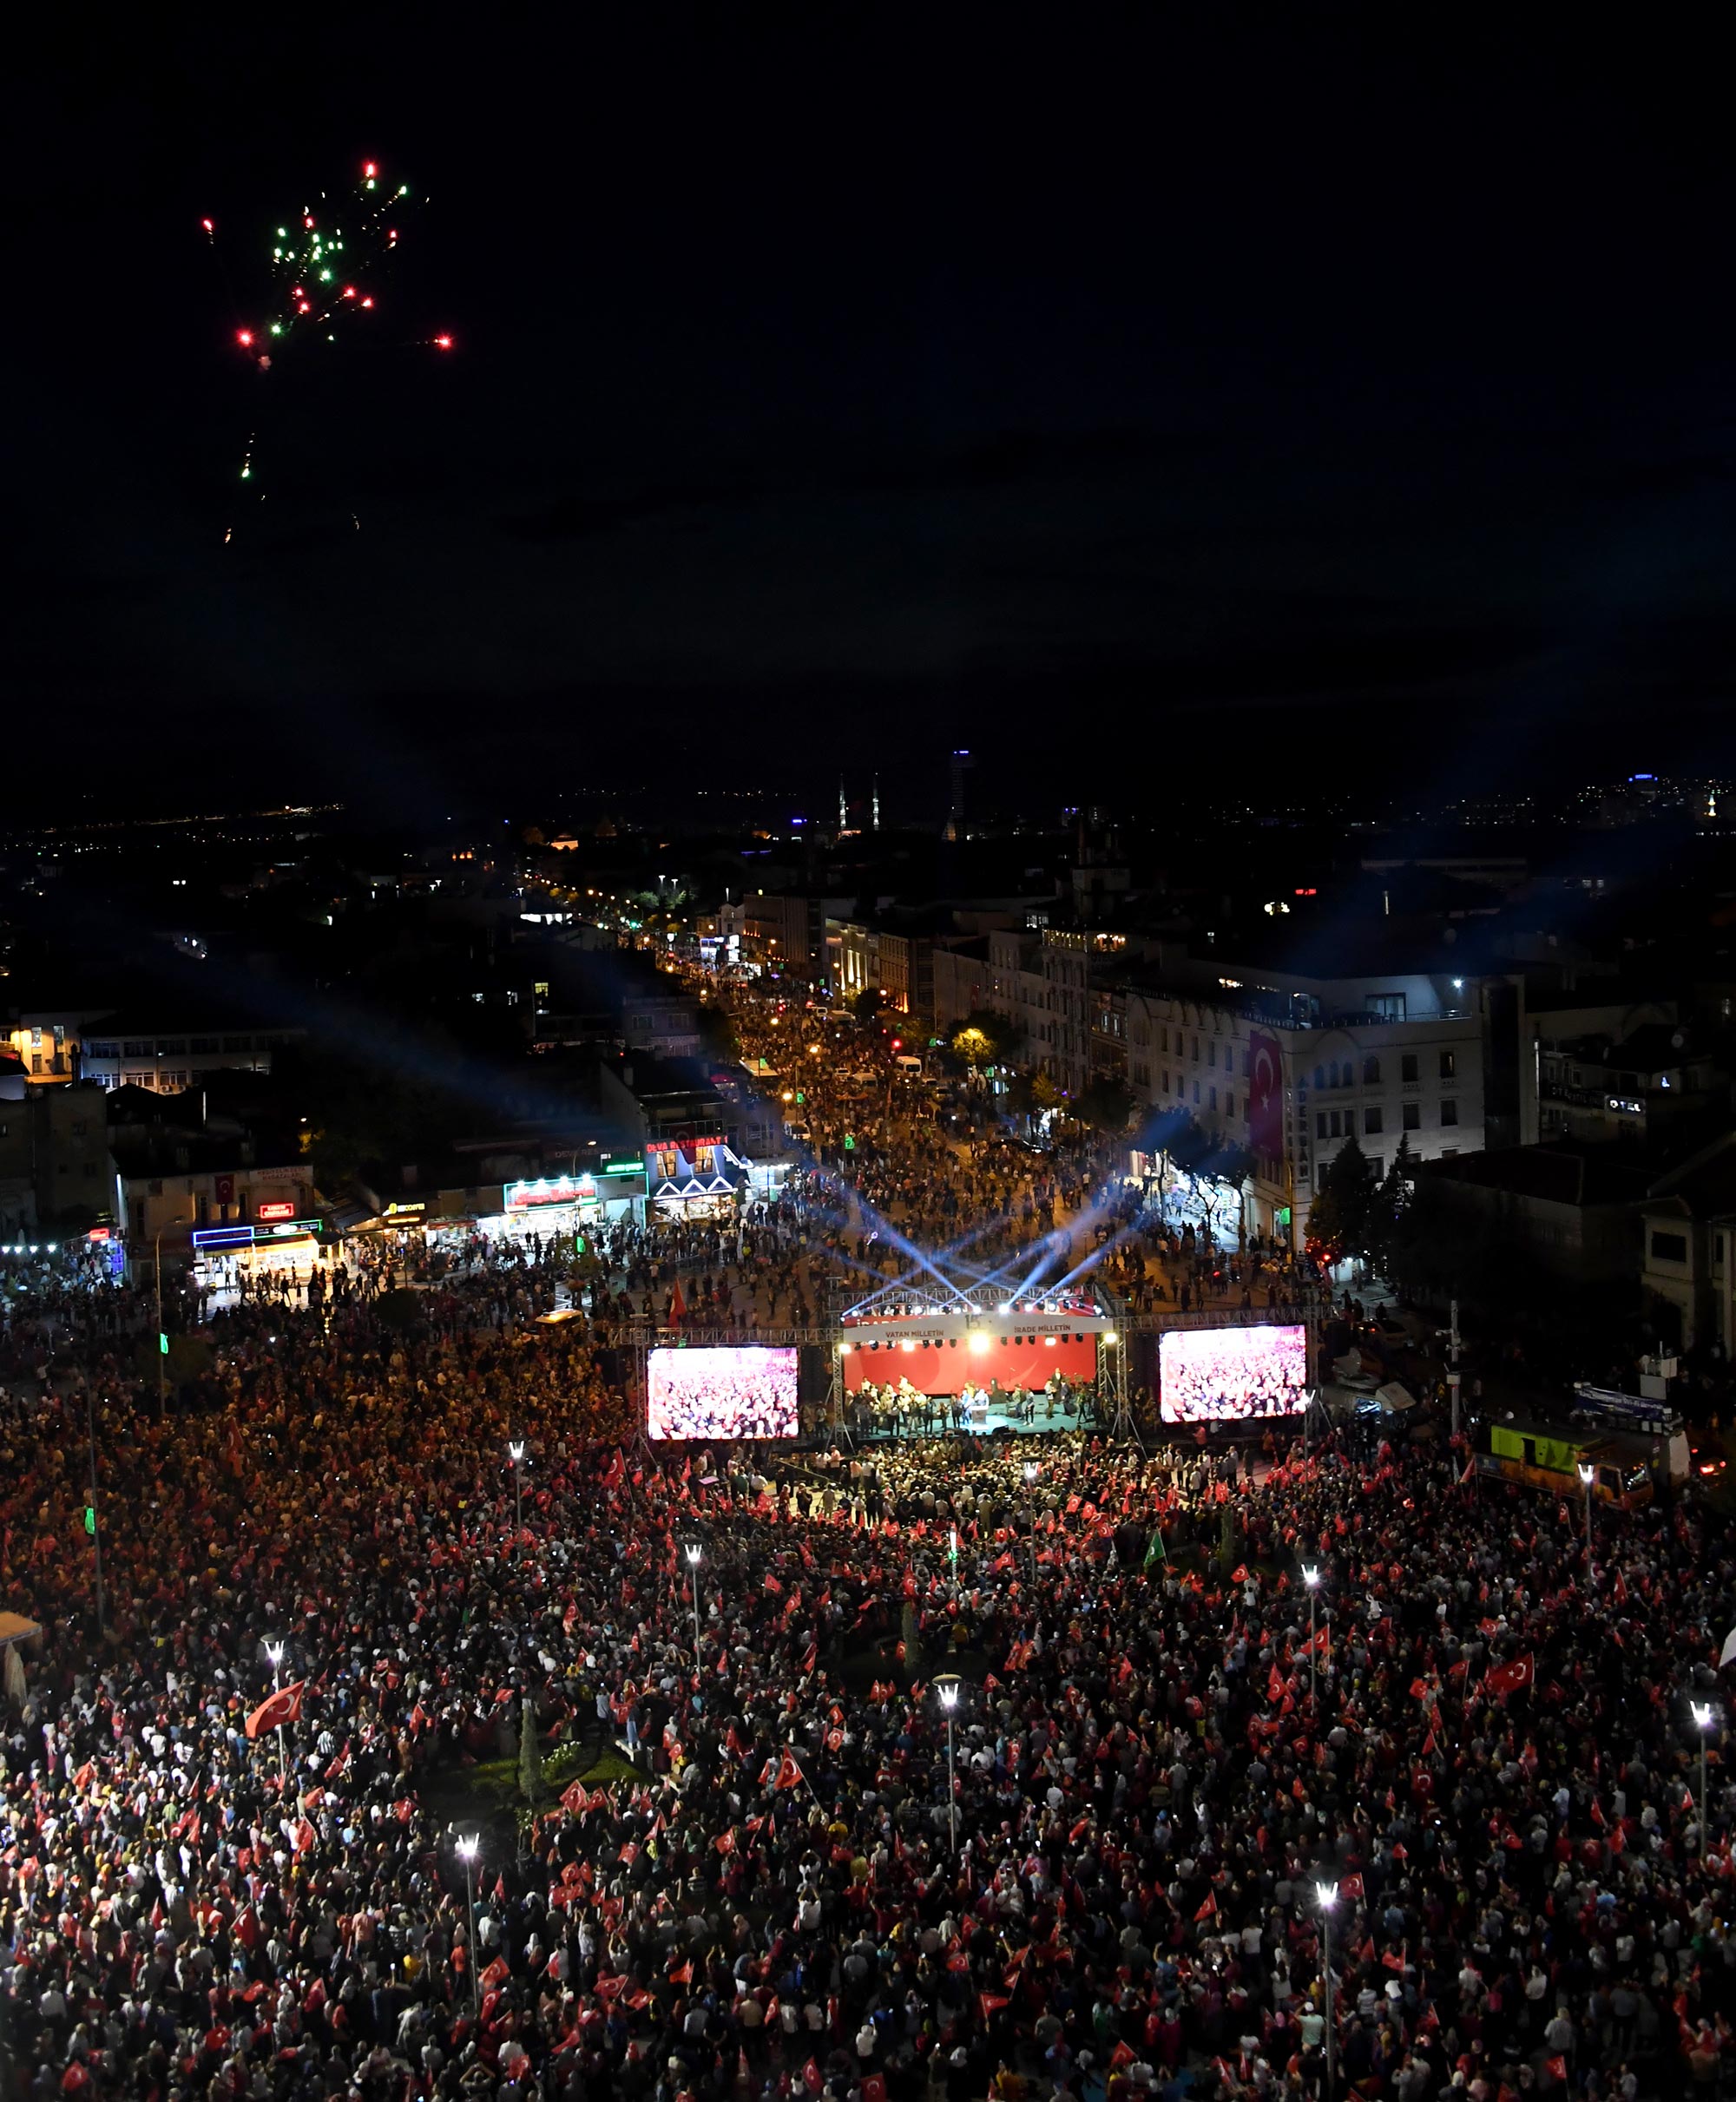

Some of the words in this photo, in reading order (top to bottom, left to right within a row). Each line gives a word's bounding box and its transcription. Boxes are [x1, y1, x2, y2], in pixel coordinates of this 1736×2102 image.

[1609, 1100, 1641, 1112] OTEL
[647, 1141, 667, 1153] DEVA
[911, 1329, 944, 1337] MİLLETİN
[1037, 1324, 1071, 1332] MİLLETİN
